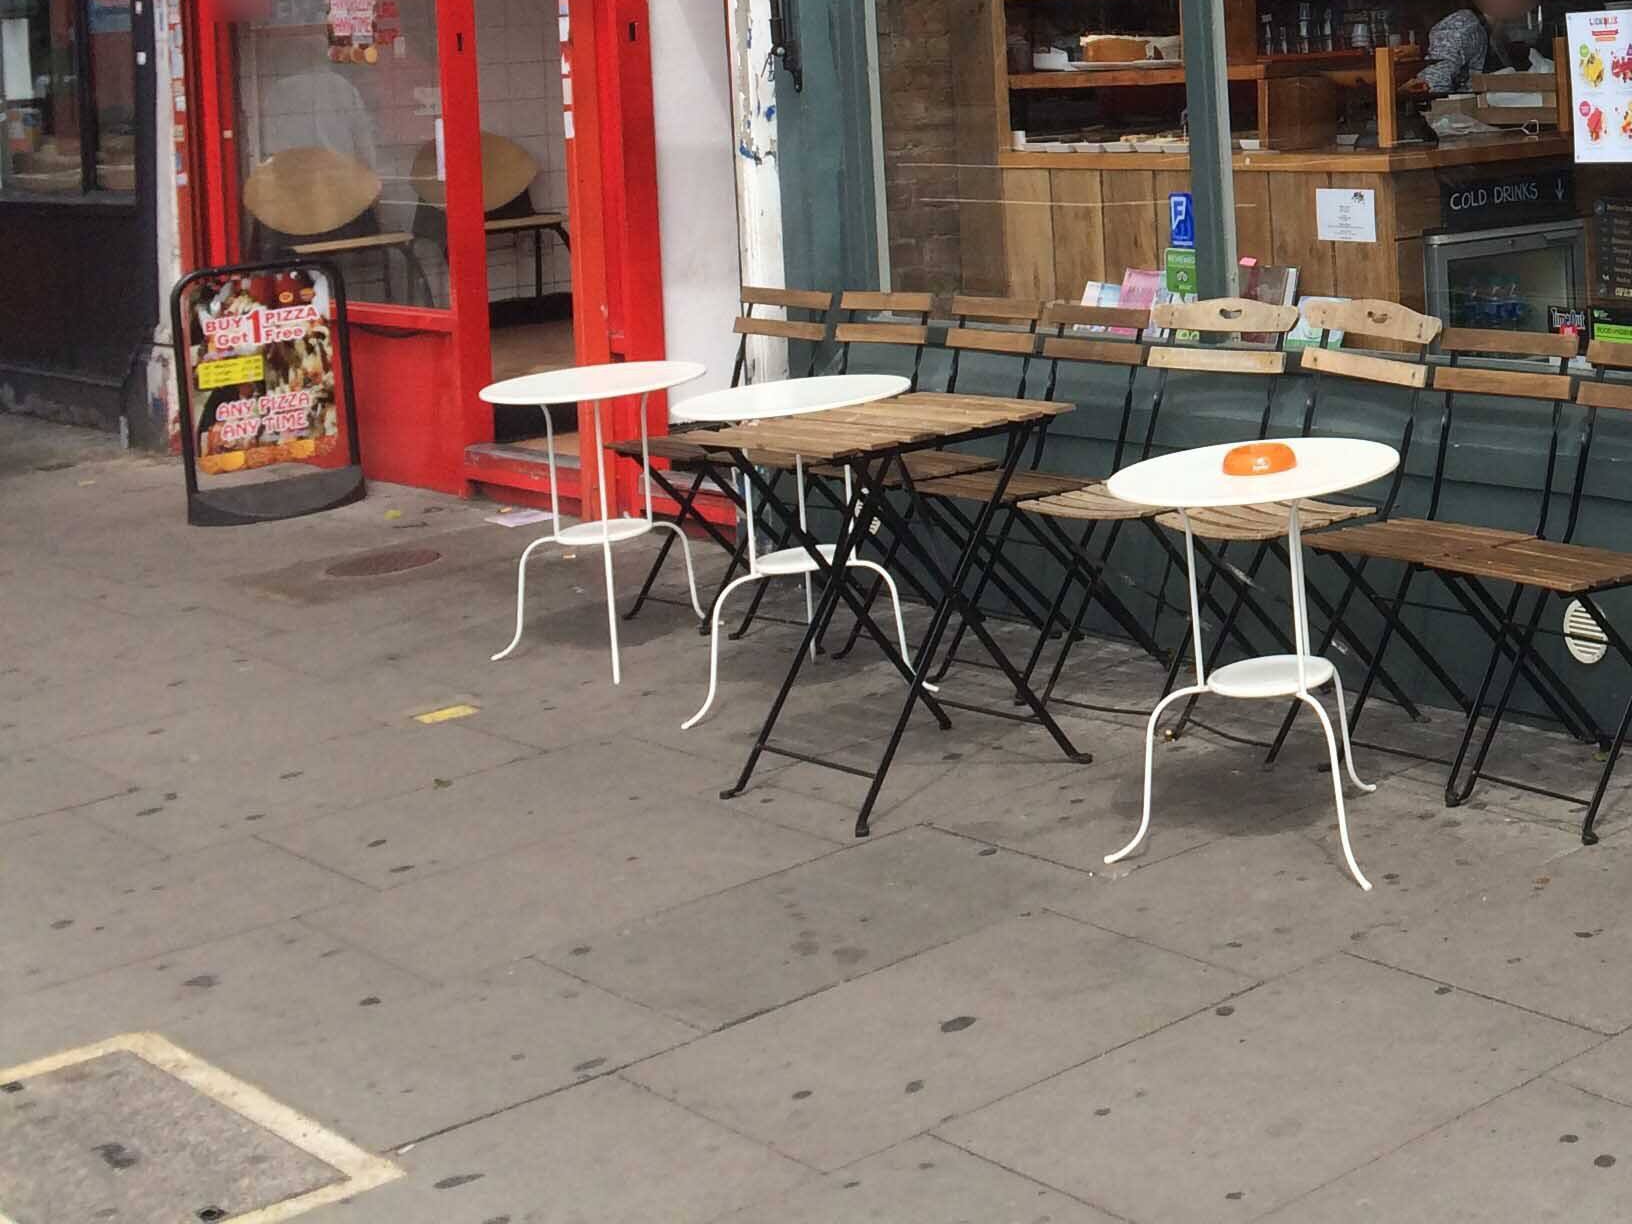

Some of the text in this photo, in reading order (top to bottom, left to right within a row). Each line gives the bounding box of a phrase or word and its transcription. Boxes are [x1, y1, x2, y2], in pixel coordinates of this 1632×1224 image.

[1450, 183, 1538, 210] COLD DRINKS
[205, 306, 319, 344] BUY 1 PIZZA
[217, 327, 303, 347] Get Free
[218, 392, 310, 418] ANY PIZZA
[223, 411, 308, 439] ANY TIME
